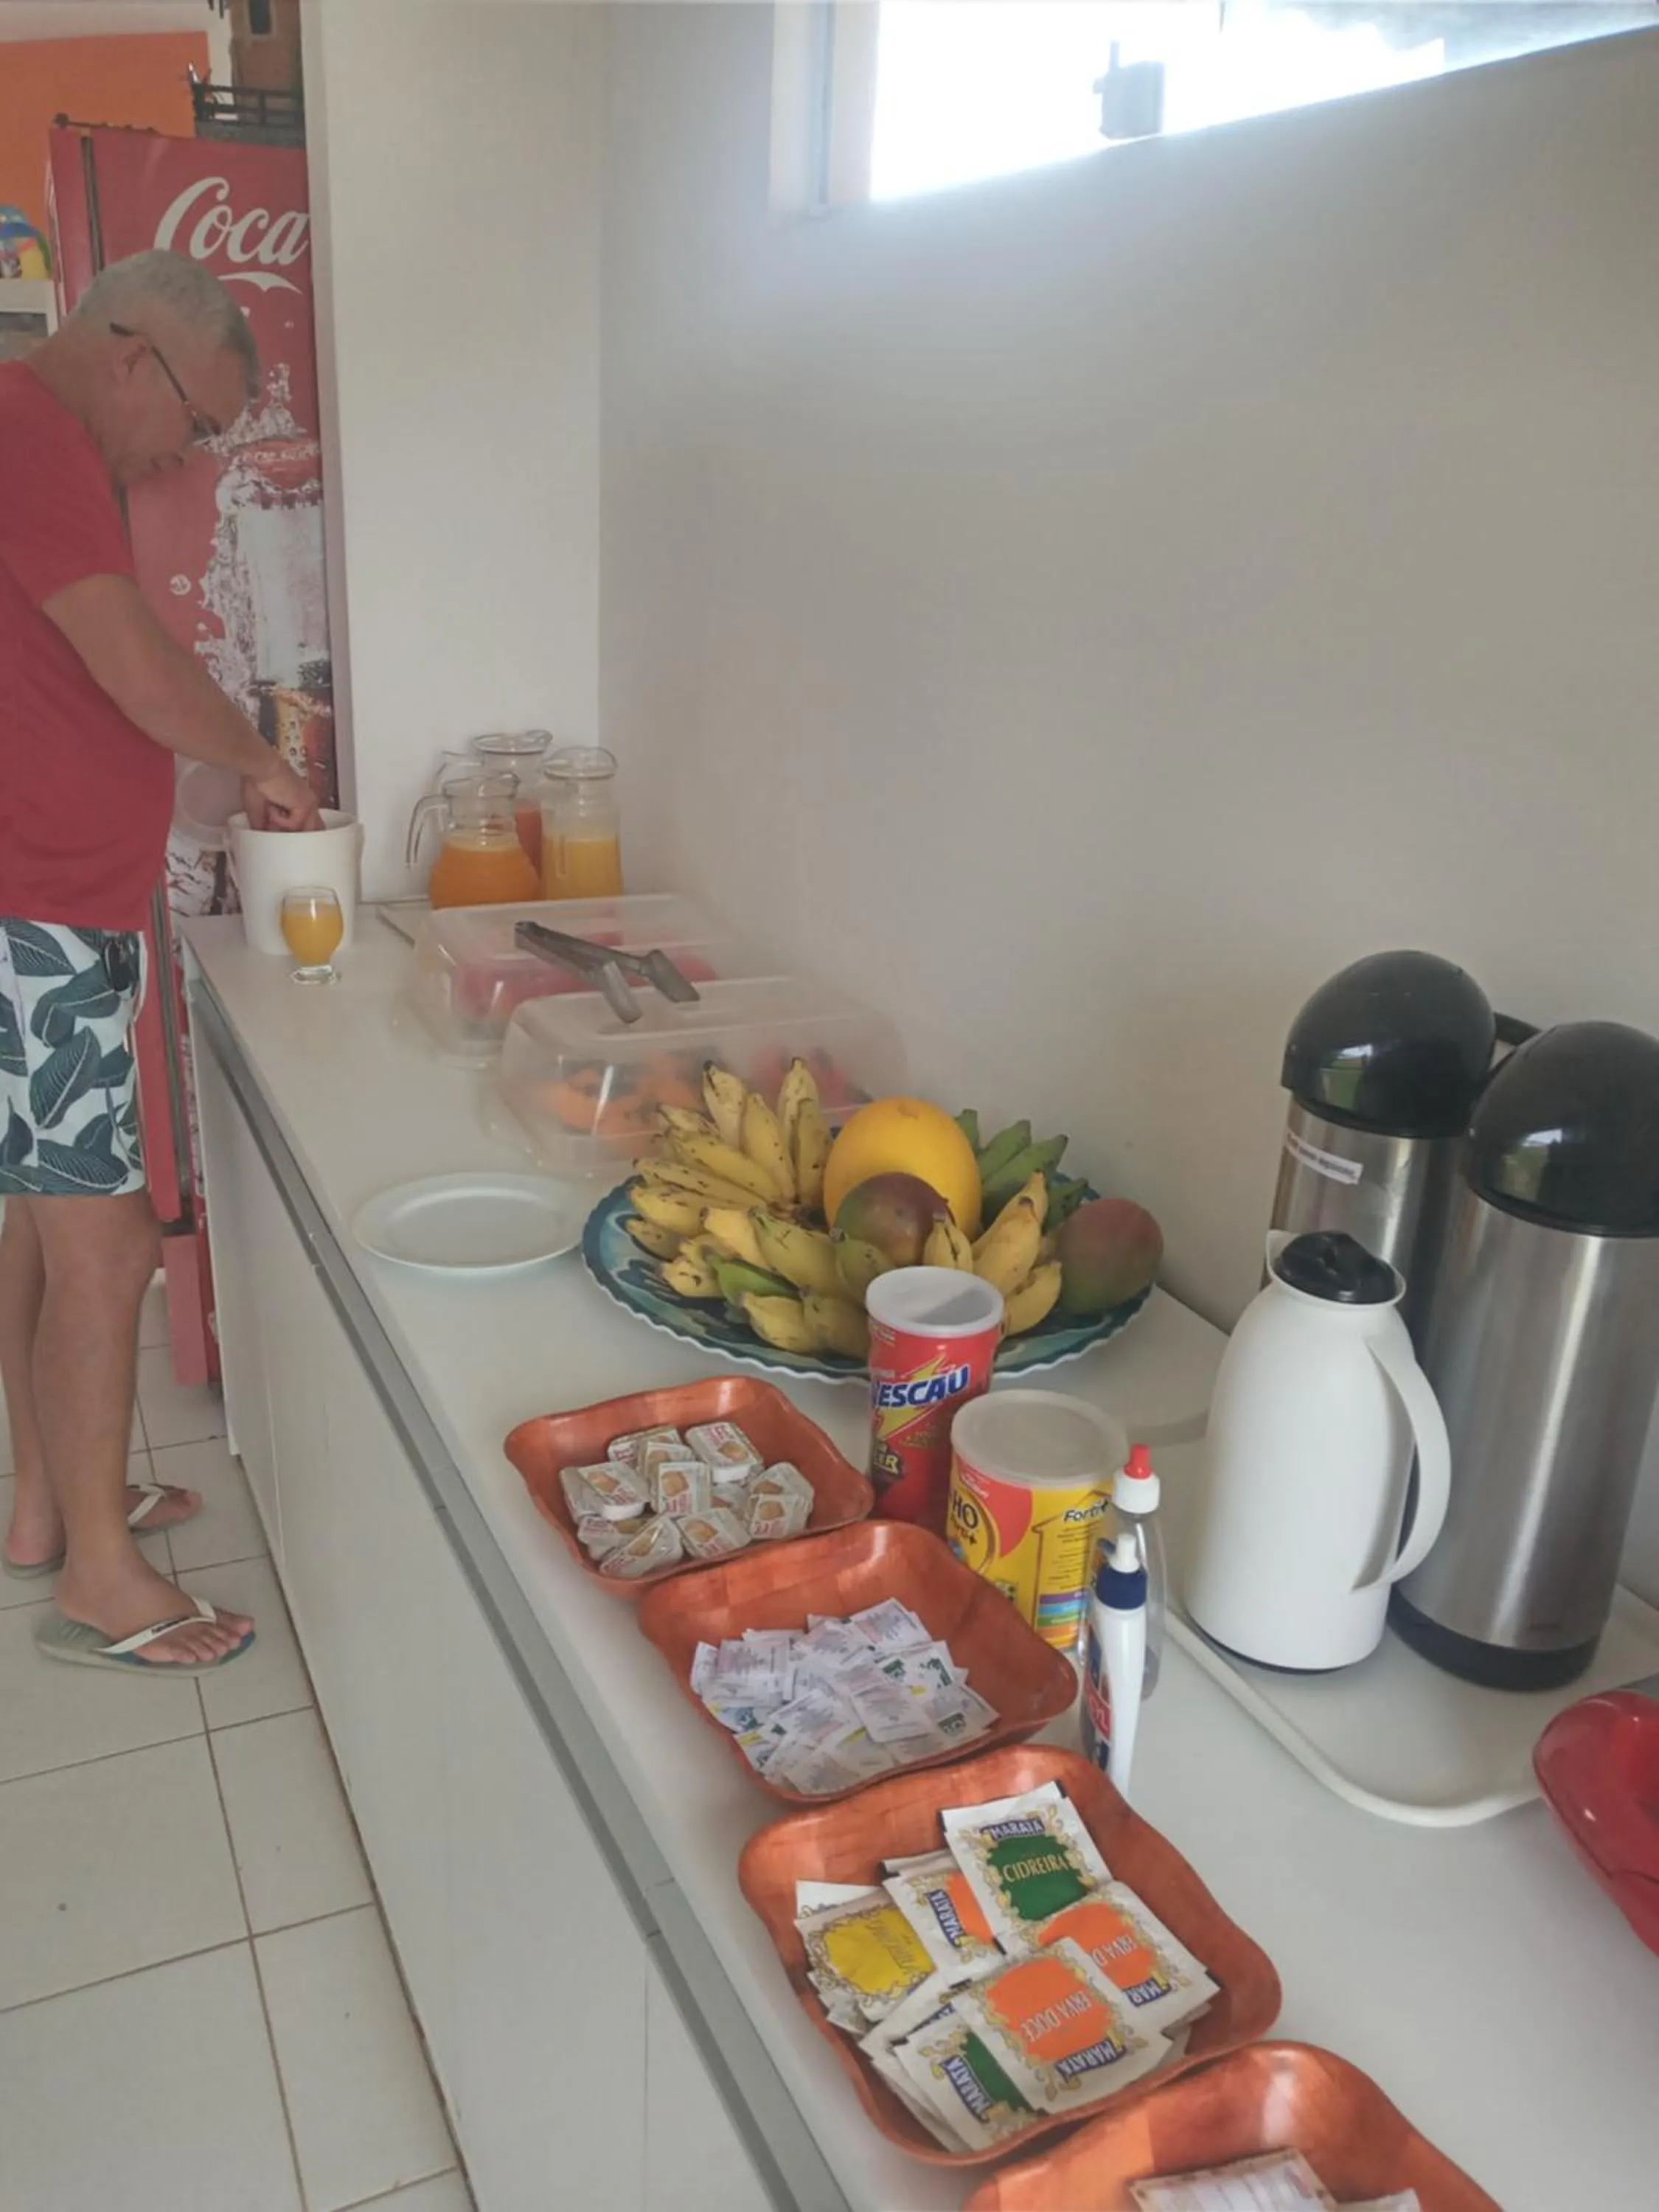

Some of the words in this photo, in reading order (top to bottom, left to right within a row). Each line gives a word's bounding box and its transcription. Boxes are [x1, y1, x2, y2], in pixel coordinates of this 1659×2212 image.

[154, 176, 309, 266] Coca
[1003, 1854, 1071, 1882] CIDREIRA
[1127, 1978, 1162, 2005] MAR
